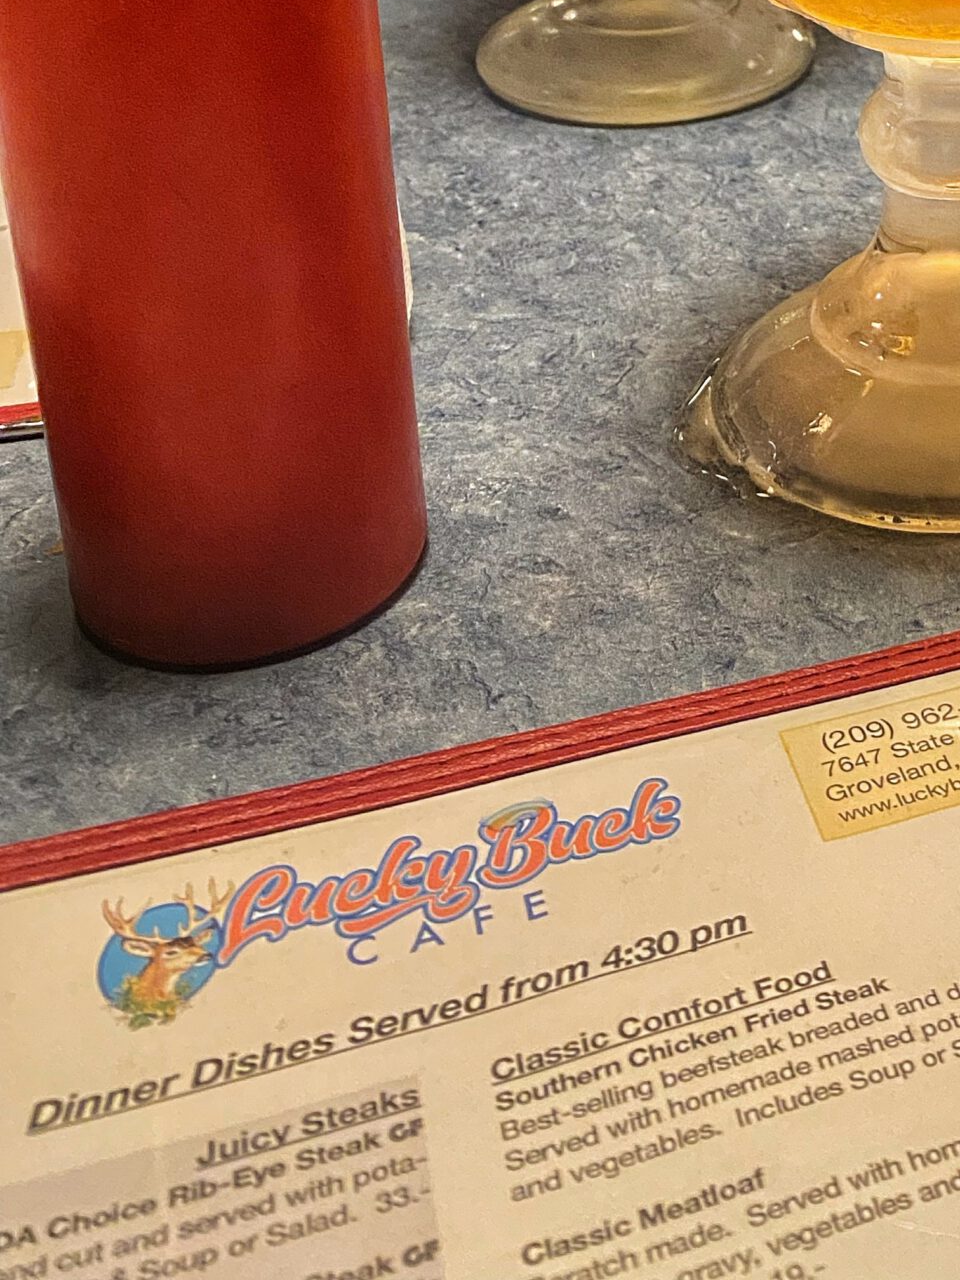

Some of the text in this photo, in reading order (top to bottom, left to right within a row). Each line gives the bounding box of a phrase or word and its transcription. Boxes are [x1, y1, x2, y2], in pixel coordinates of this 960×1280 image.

[821, 748, 882, 777] 7647
[890, 731, 954, 759] State
[822, 718, 894, 755] (209)
[826, 756, 960, 802] Groveland,
[216, 777, 680, 967] Lucky Buck
[347, 890, 548, 965] CAFE
[27, 913, 748, 1133] Dinner Dishes Served from 4:30 pm
[491, 960, 833, 1081] Classic Comfort Food
[495, 976, 890, 1112] Southern Chicken Fried Steak
[500, 1080, 655, 1142] Best-selling
[660, 1037, 786, 1089] beefsteak
[790, 1004, 889, 1049] breaded
[895, 989, 941, 1017] and
[196, 1088, 420, 1167] Juicy Steaks
[505, 1125, 601, 1172] Served
[607, 1106, 663, 1139] with
[668, 1058, 812, 1118] homemade
[818, 1026, 916, 1070] mashed
[510, 1172, 563, 1202] and
[568, 1121, 724, 1184] vegetables.
[735, 1081, 845, 1128] Includes
[850, 1058, 915, 1091] Soup
[922, 1048, 947, 1069] or
[47, 1198, 157, 1238] Choice
[169, 1161, 287, 1208] Rib-Eye
[296, 1132, 382, 1171] Steak
[389, 1118, 423, 1143] GF
[55, 1243, 103, 1272] cut
[112, 1224, 169, 1257] and
[176, 1193, 275, 1240] served
[284, 1175, 344, 1208] with
[353, 1156, 427, 1193] pota-
[521, 1167, 766, 1267] Classic Meatloaf
[645, 1222, 734, 1264] made.
[747, 1176, 842, 1227] Served
[848, 1158, 905, 1191] with
[766, 1191, 914, 1257] vegetables
[138, 1247, 219, 1280] Soup
[228, 1234, 259, 1258] or
[265, 1204, 358, 1247] Salad.
